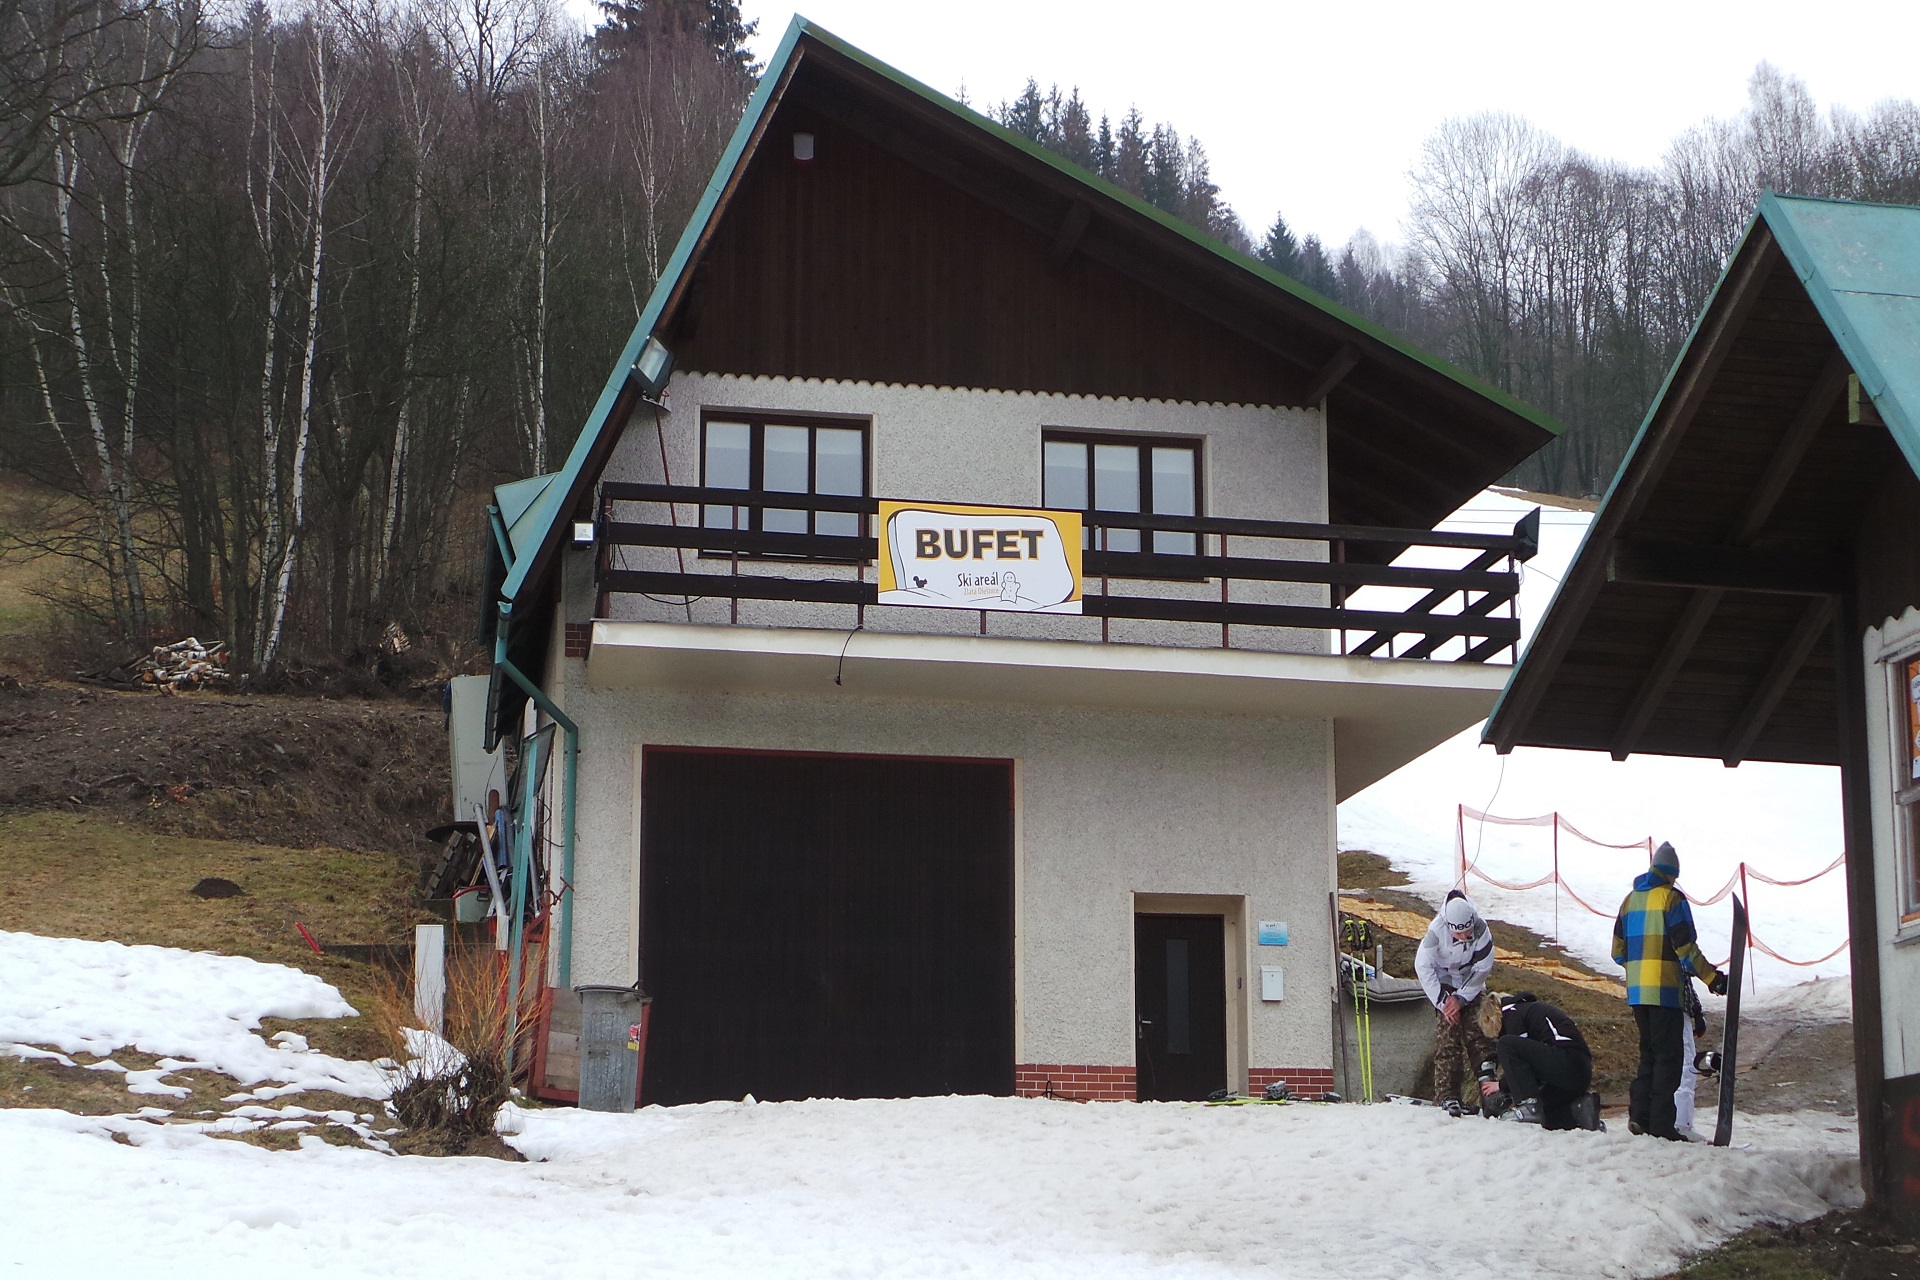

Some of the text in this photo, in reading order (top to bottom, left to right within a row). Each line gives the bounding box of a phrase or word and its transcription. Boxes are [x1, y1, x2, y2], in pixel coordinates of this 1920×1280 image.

[915, 528, 1044, 560] BUFET
[957, 572, 999, 587] Ski areál
